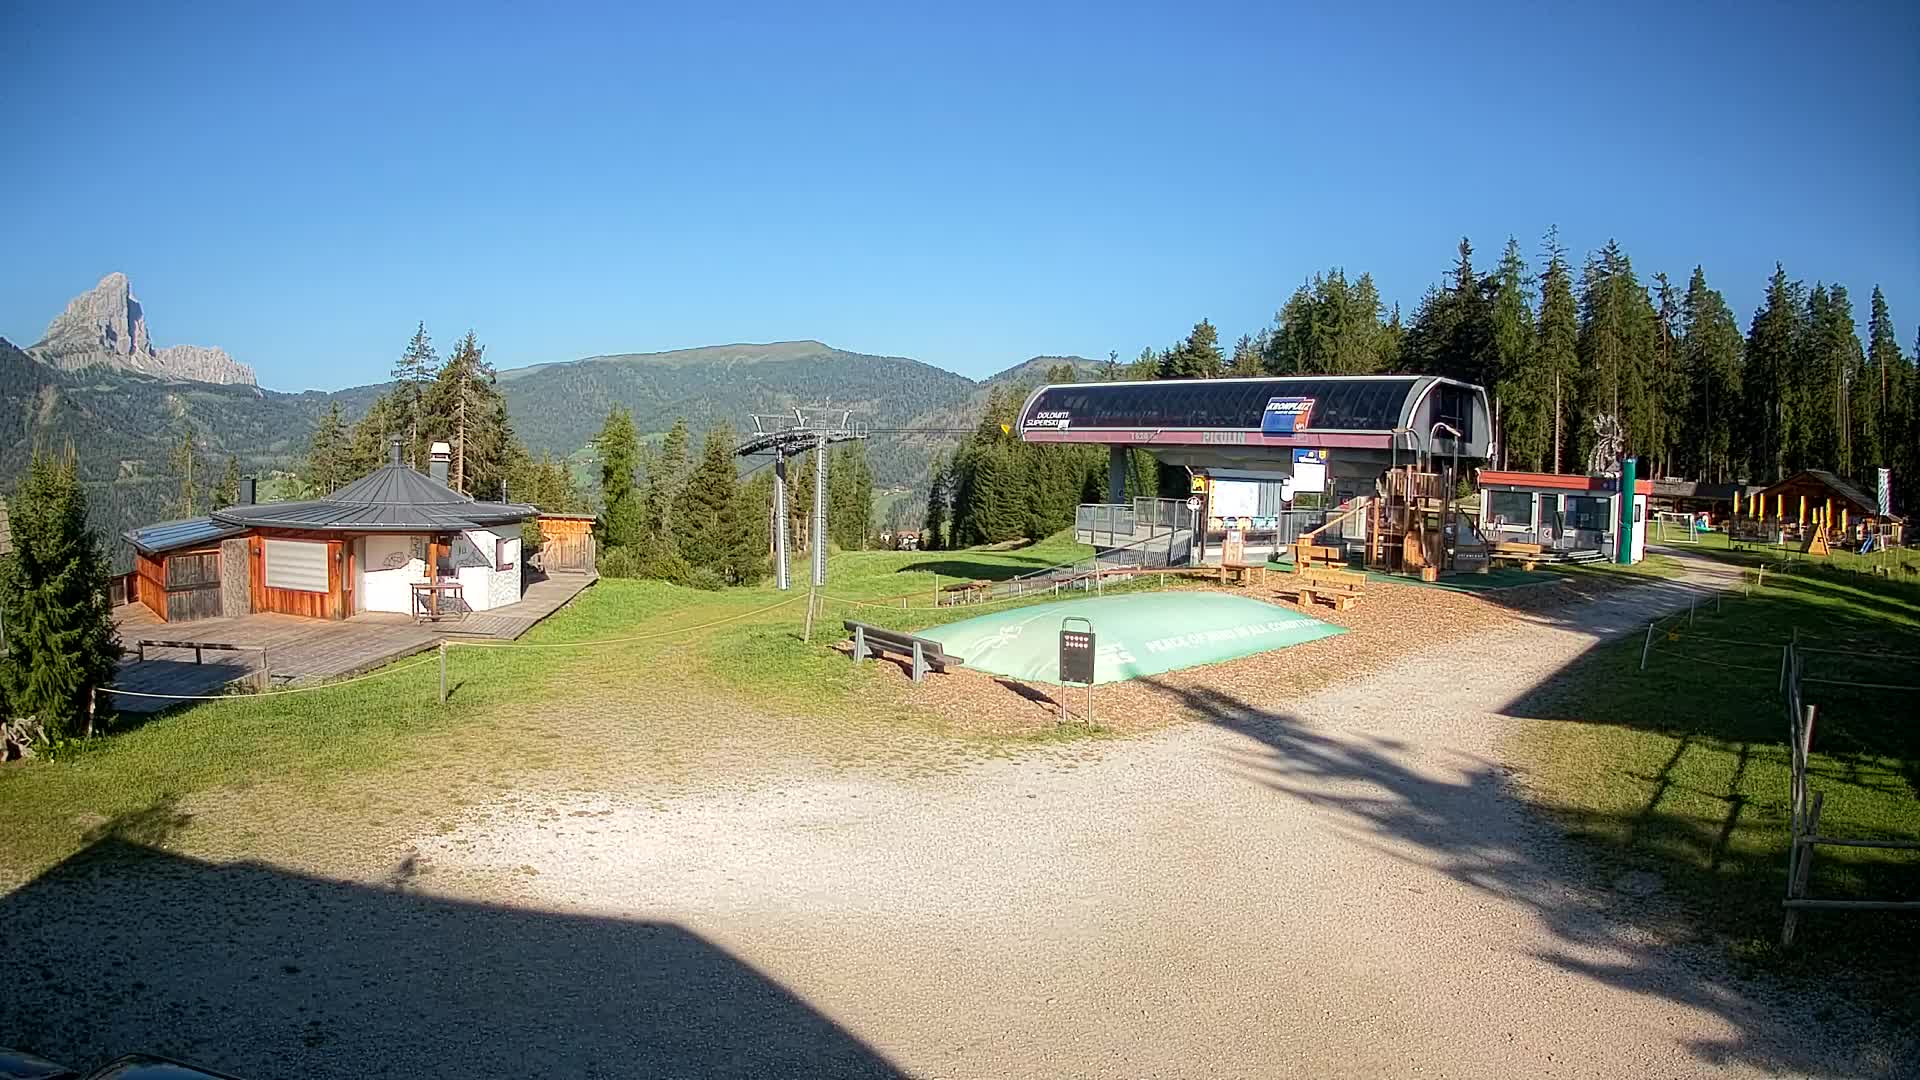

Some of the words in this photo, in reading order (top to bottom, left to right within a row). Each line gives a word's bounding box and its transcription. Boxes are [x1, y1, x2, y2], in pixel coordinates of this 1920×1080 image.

[1266, 402, 1311, 411] KRONPLATZ
[1036, 411, 1070, 419] DOLOMITI
[1025, 419, 1059, 427] SUPERSKI
